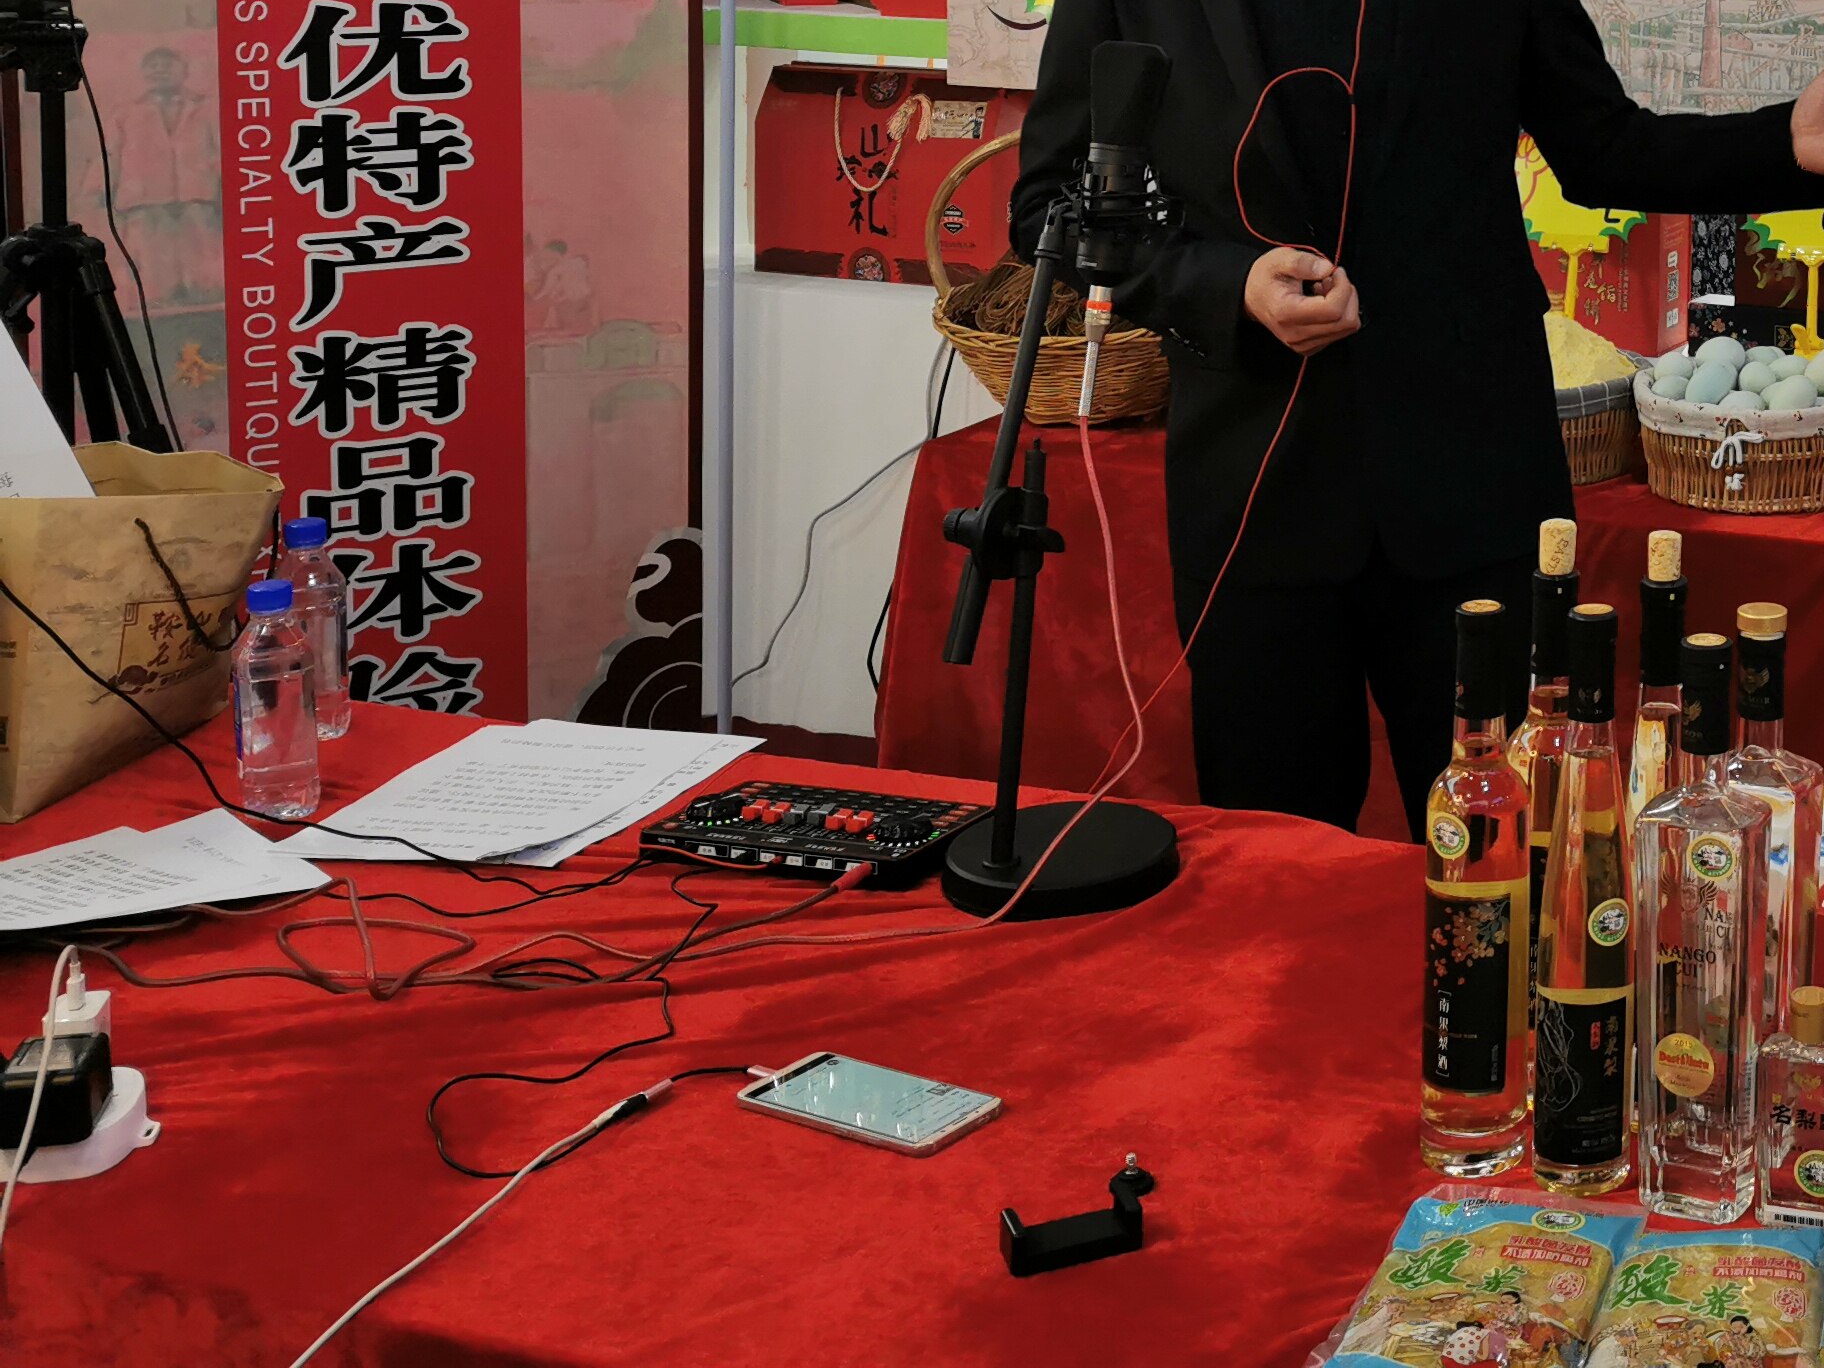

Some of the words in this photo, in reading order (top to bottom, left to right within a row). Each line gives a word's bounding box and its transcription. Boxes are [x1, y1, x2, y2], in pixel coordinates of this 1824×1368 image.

[234, 42, 276, 268] SPECIALTY
[239, 287, 280, 478] BOUTIQU
[1658, 942, 1717, 966] NANGO
[1389, 1238, 1529, 1296] 酸菜
[1610, 1254, 1771, 1320] 酸菜
